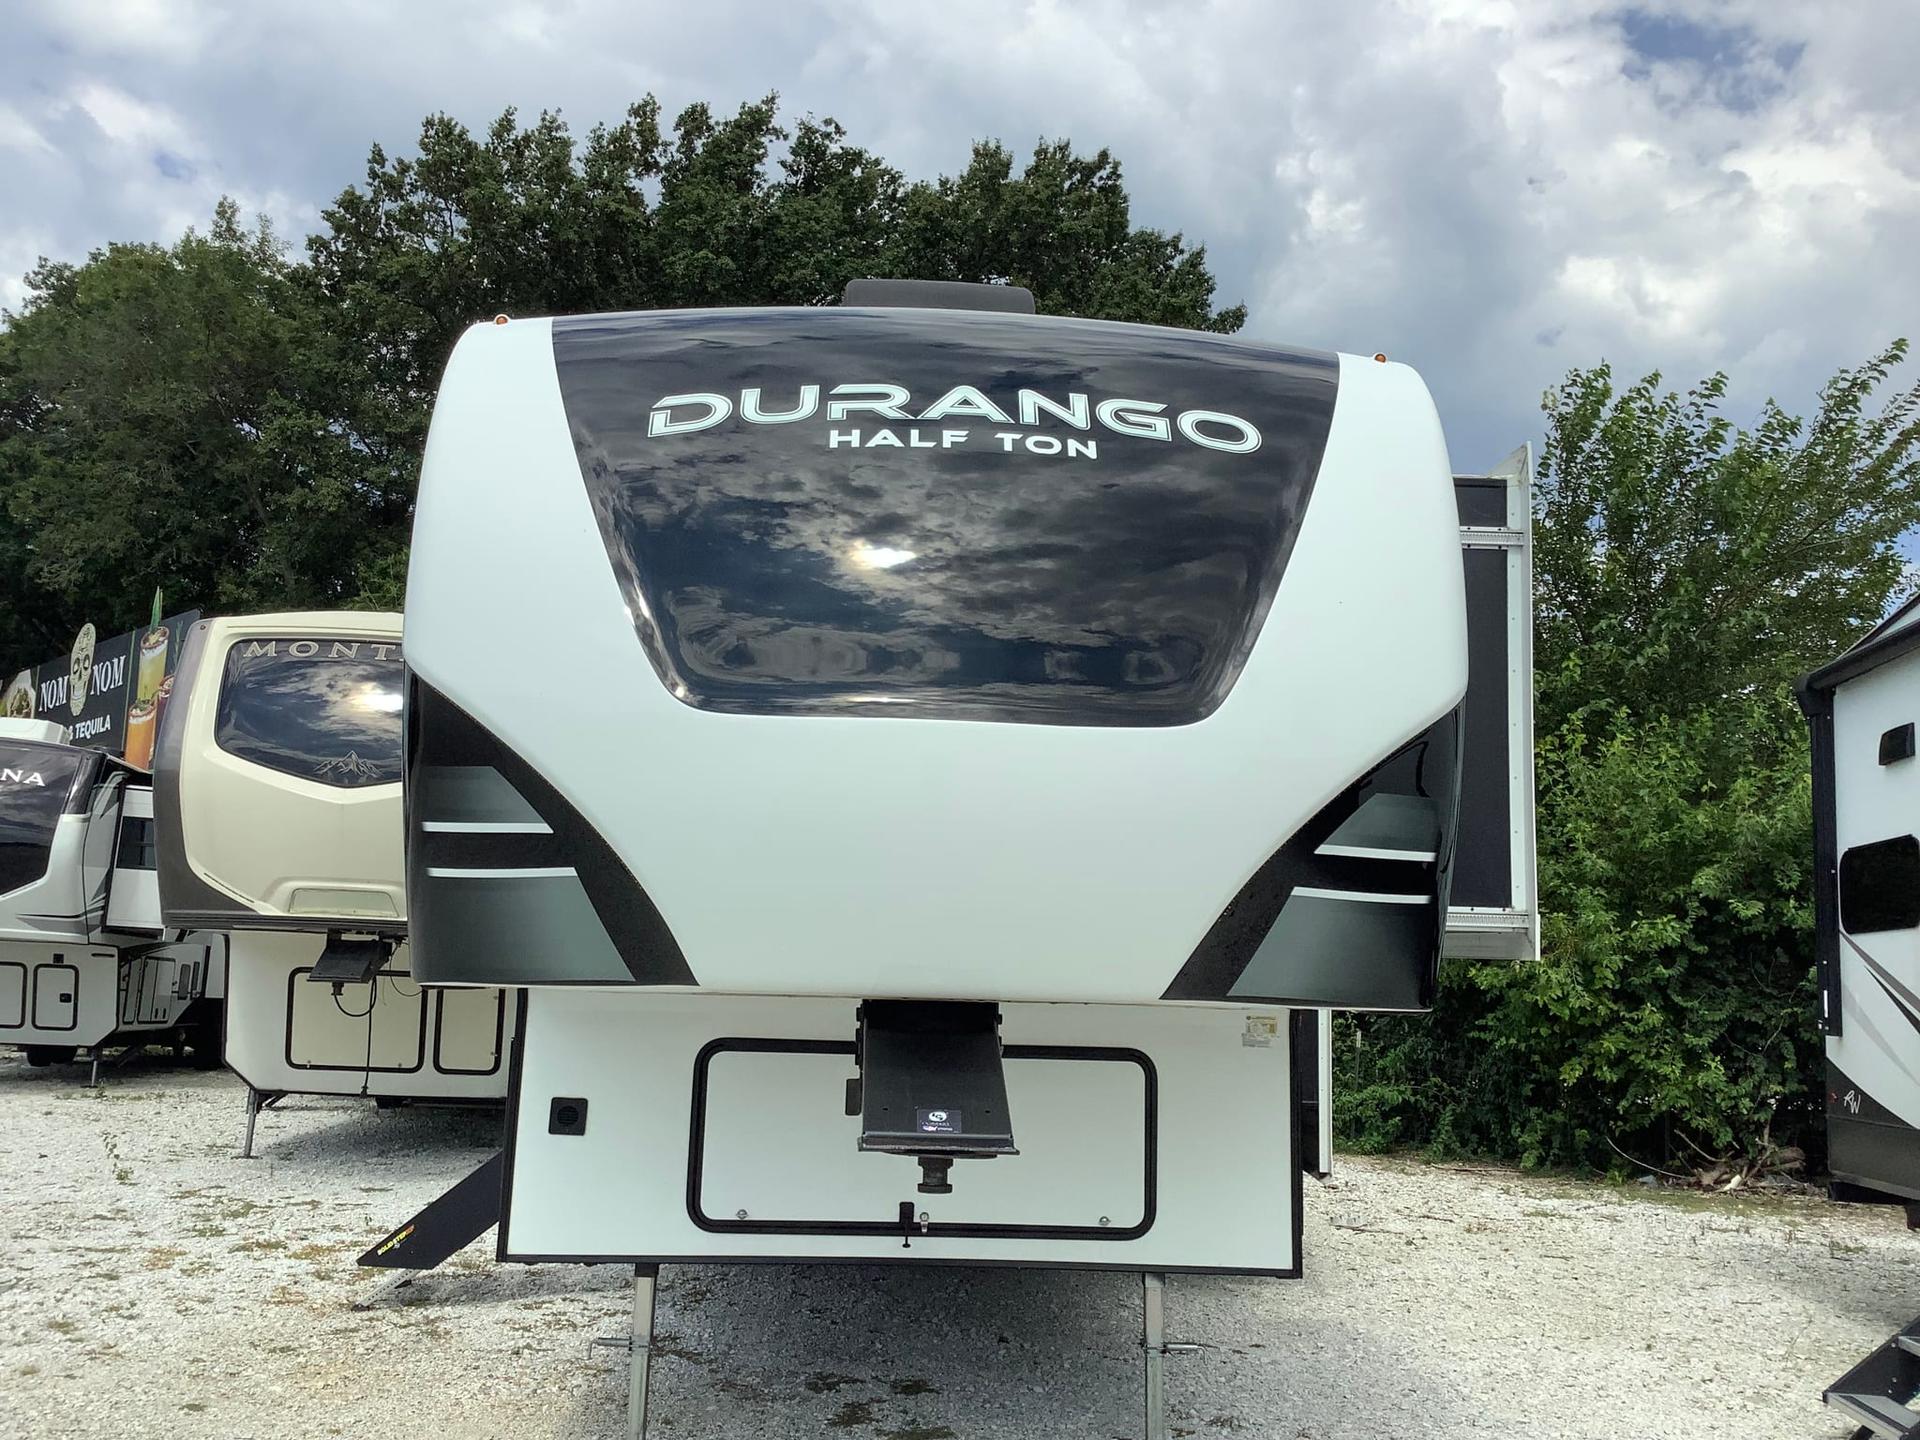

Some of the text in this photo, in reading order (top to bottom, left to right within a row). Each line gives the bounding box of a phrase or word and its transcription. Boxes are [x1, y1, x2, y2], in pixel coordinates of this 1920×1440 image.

[647, 383, 1262, 454] DURANGO
[829, 429, 1098, 460] HALF TON
[243, 640, 404, 662] MONT
[39, 655, 126, 712] NOM NOM
[75, 714, 111, 739] TEQUILA
